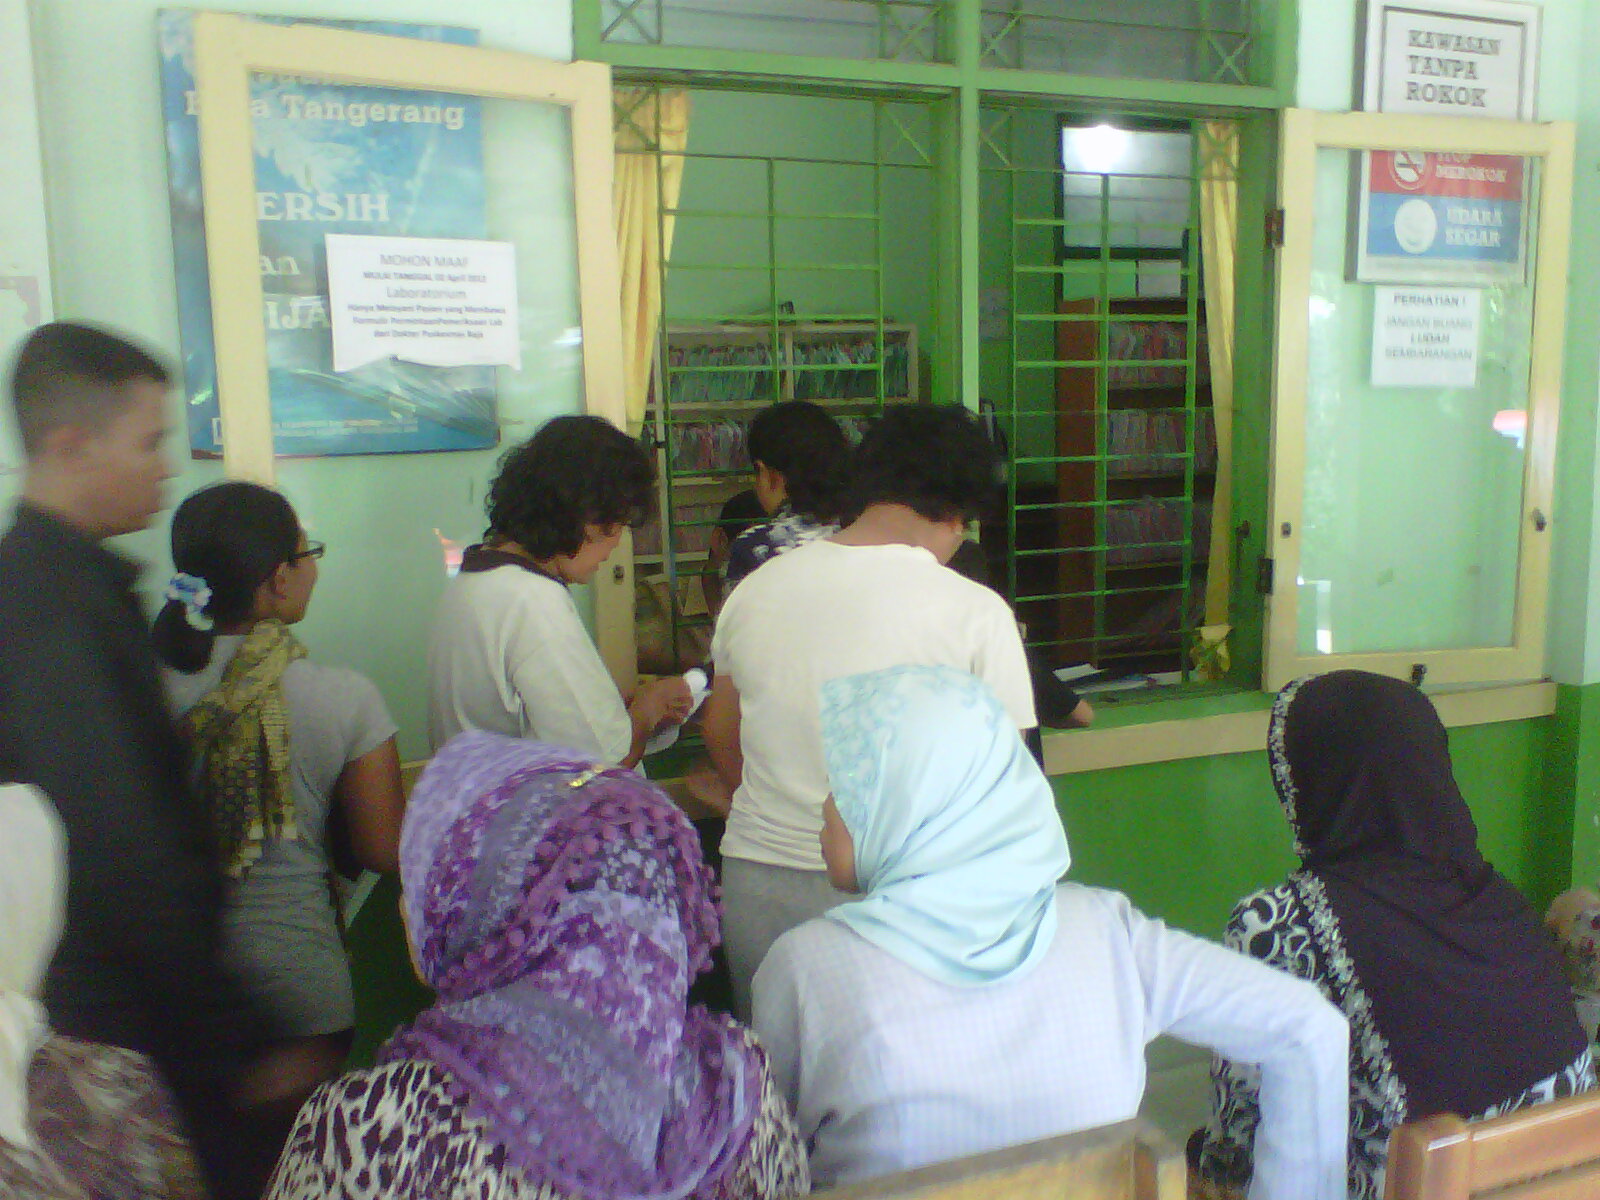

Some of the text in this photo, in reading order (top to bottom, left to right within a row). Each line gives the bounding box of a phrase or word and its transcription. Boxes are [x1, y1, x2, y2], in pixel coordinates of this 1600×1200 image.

[1408, 29, 1501, 56] KAWASAN
[1408, 55, 1478, 80] TANPA
[1407, 81, 1487, 108] ROKOK
[281, 95, 465, 130] Tangerang
[256, 191, 390, 222] ERSIH
[1446, 227, 1501, 247] SEGAR
[387, 286, 467, 300] Laboratorium
